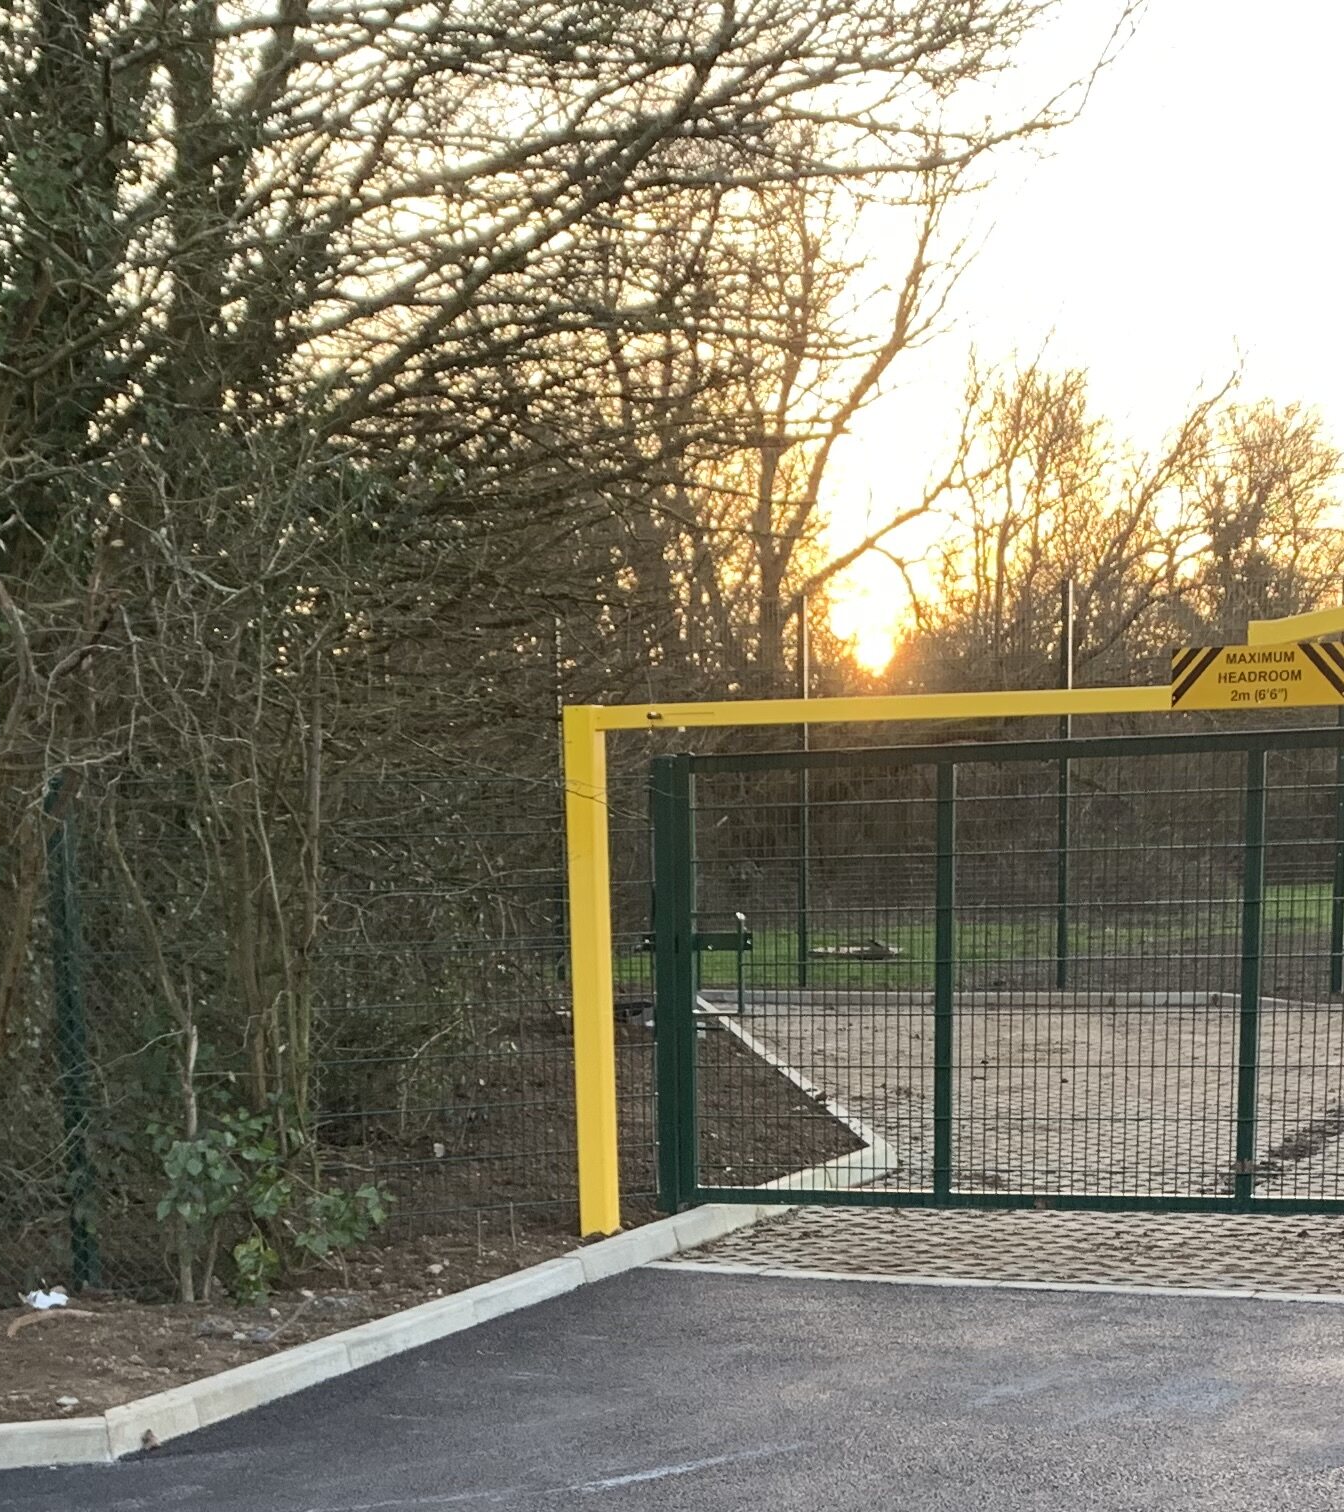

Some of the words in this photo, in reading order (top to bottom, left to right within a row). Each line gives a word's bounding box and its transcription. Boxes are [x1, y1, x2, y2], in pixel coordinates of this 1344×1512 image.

[1225, 651, 1295, 665] MAXIMUM
[1217, 669, 1302, 684] HEADROOM
[1230, 689, 1251, 702] 2m
